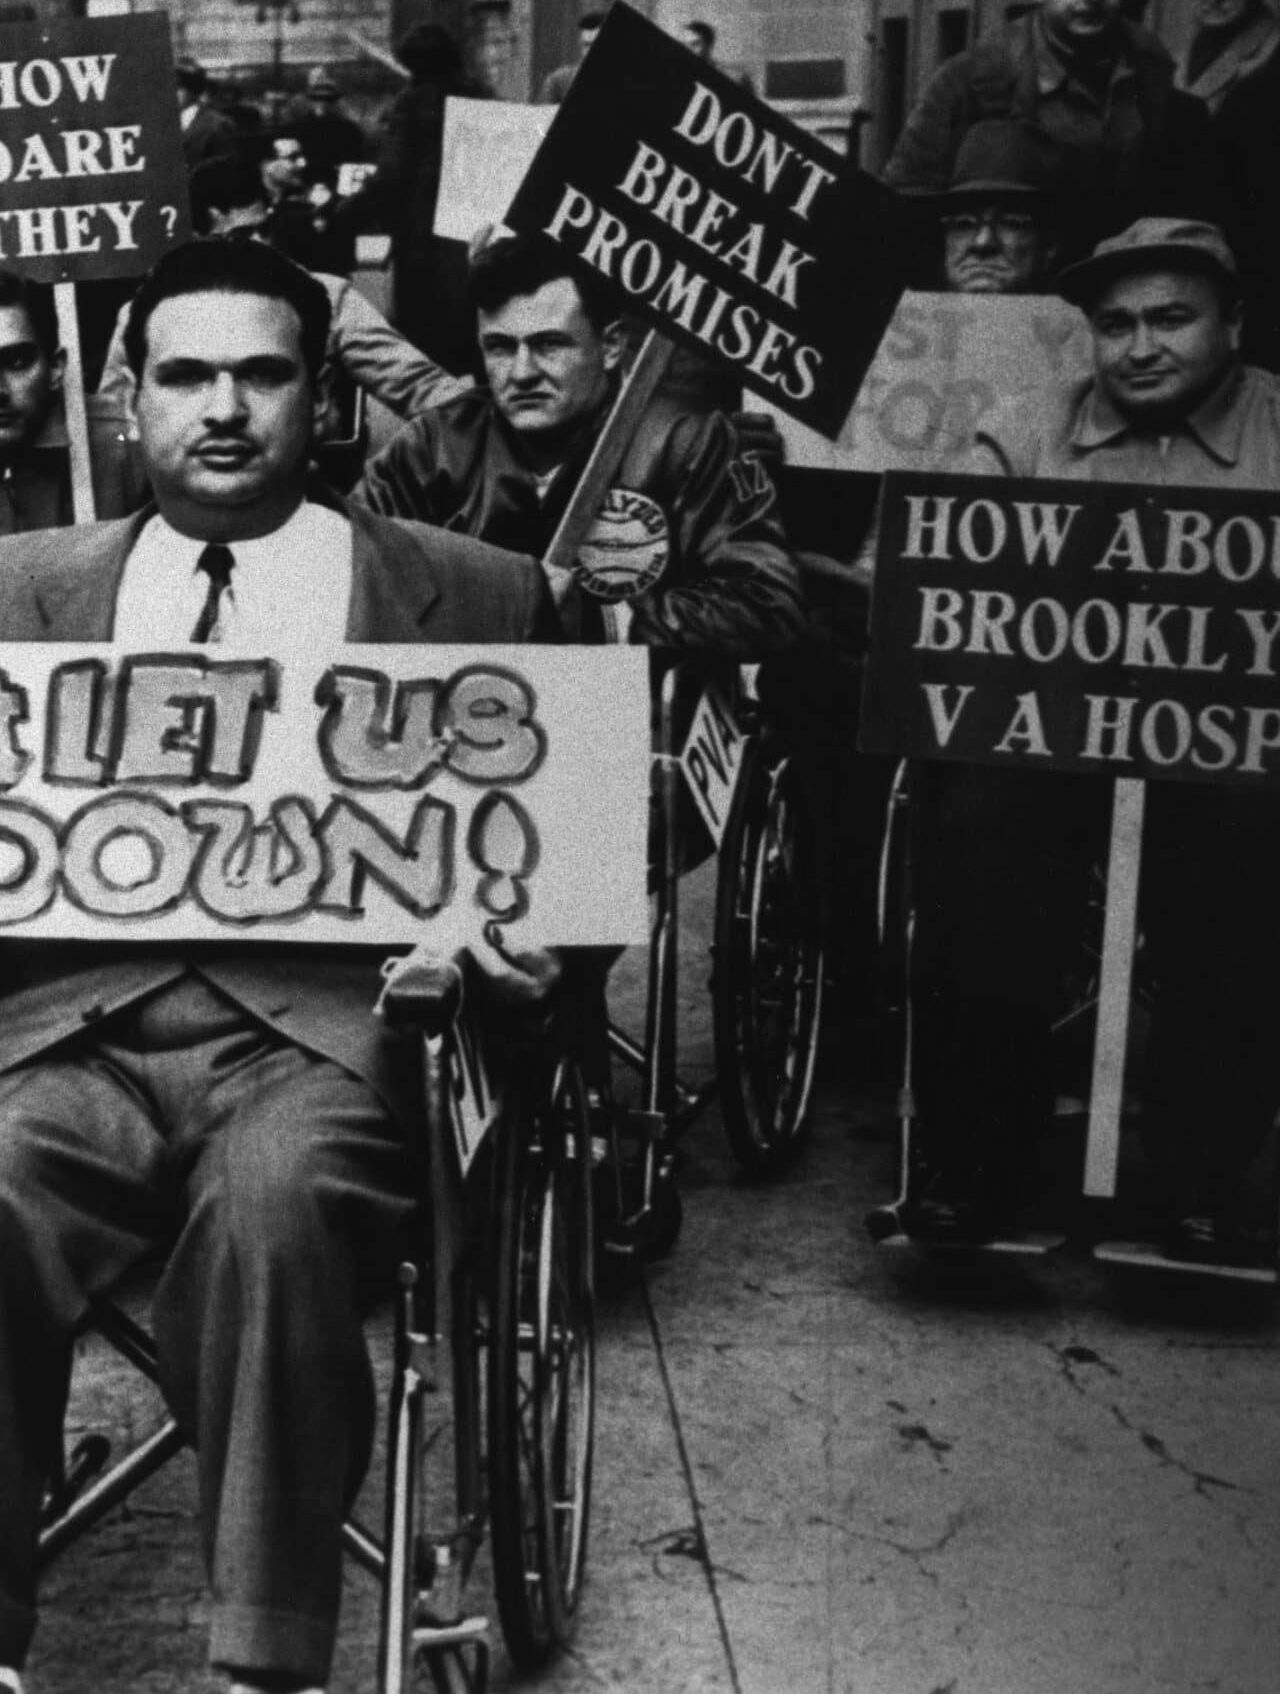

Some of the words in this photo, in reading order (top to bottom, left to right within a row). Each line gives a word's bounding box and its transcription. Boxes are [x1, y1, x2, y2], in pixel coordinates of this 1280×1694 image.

[672, 81, 838, 221] DON'T
[541, 183, 823, 401] PROMISES
[615, 140, 817, 310] BREAK
[899, 494, 1084, 567] HOW
[912, 586, 1280, 677] BROOKLY
[41, 652, 283, 788] LET
[920, 682, 976, 748] V
[993, 690, 1054, 757] A
